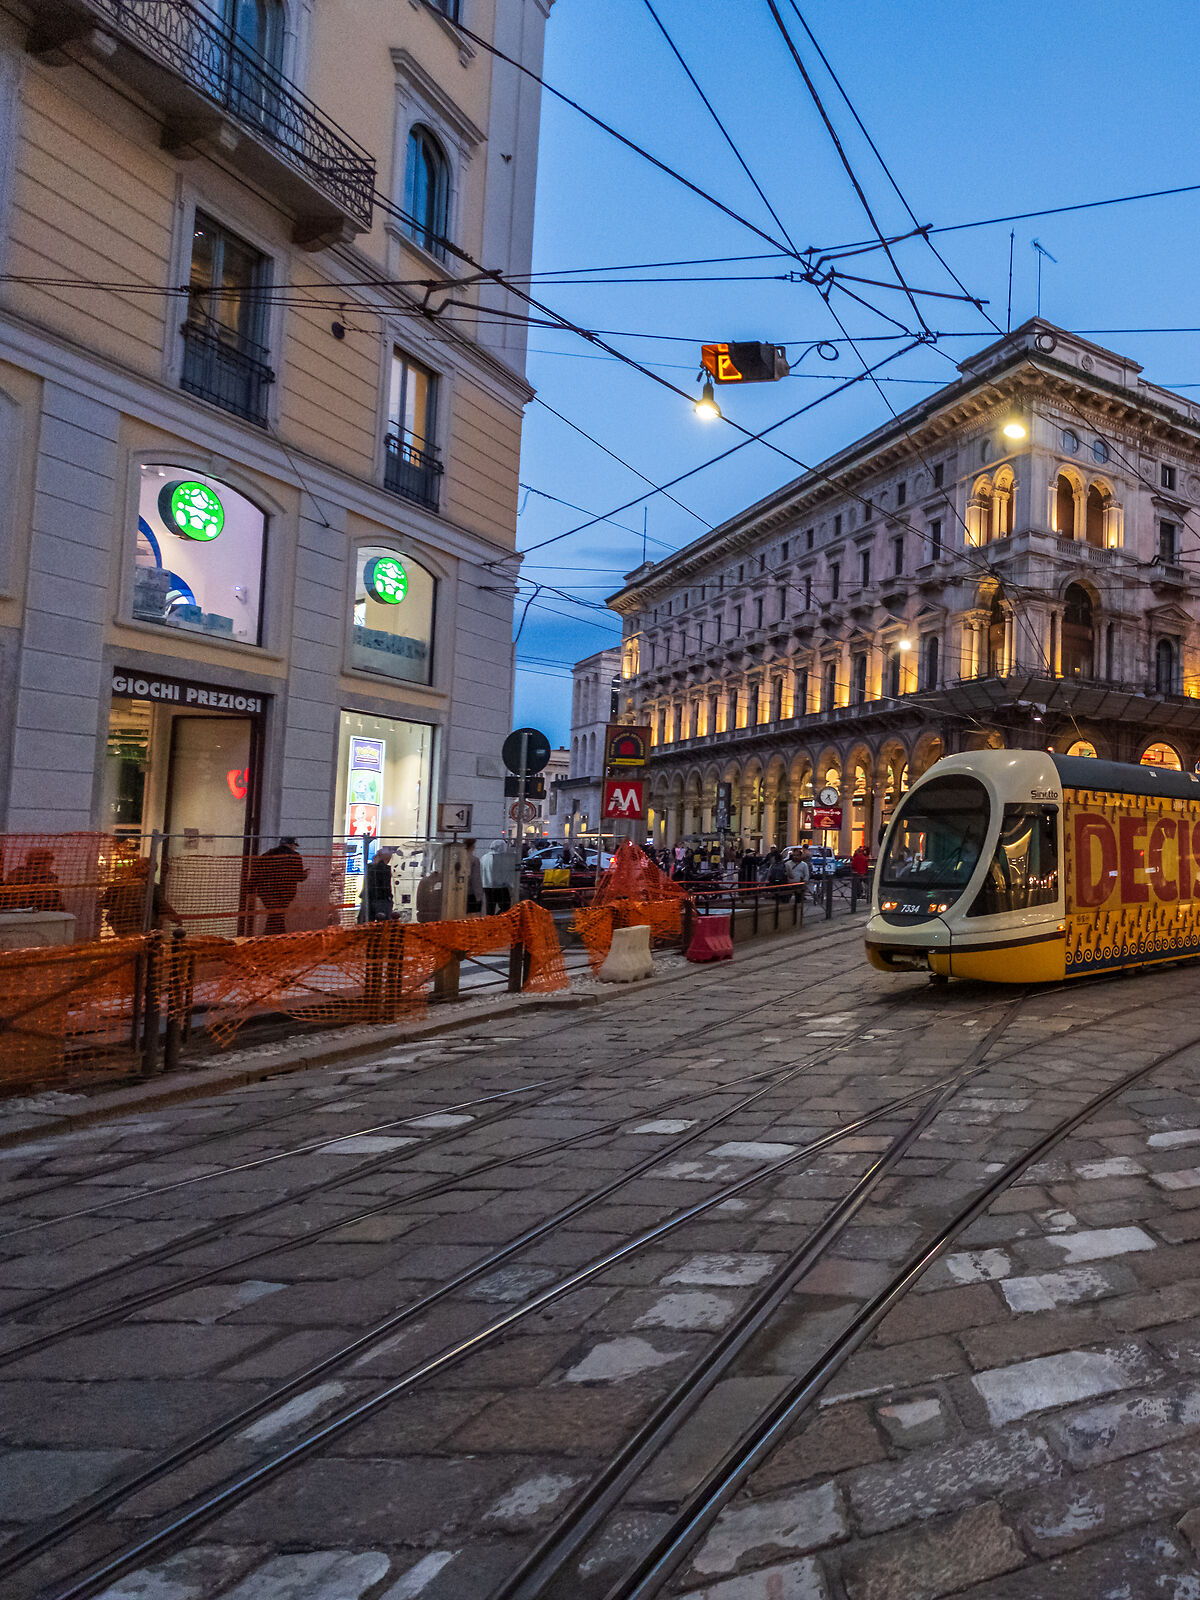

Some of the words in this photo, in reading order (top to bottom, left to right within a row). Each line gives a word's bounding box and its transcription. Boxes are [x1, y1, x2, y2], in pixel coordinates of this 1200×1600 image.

[112, 676, 180, 701] GIOCHI
[186, 687, 261, 713] PREZIOSI
[900, 904, 920, 913] 7534
